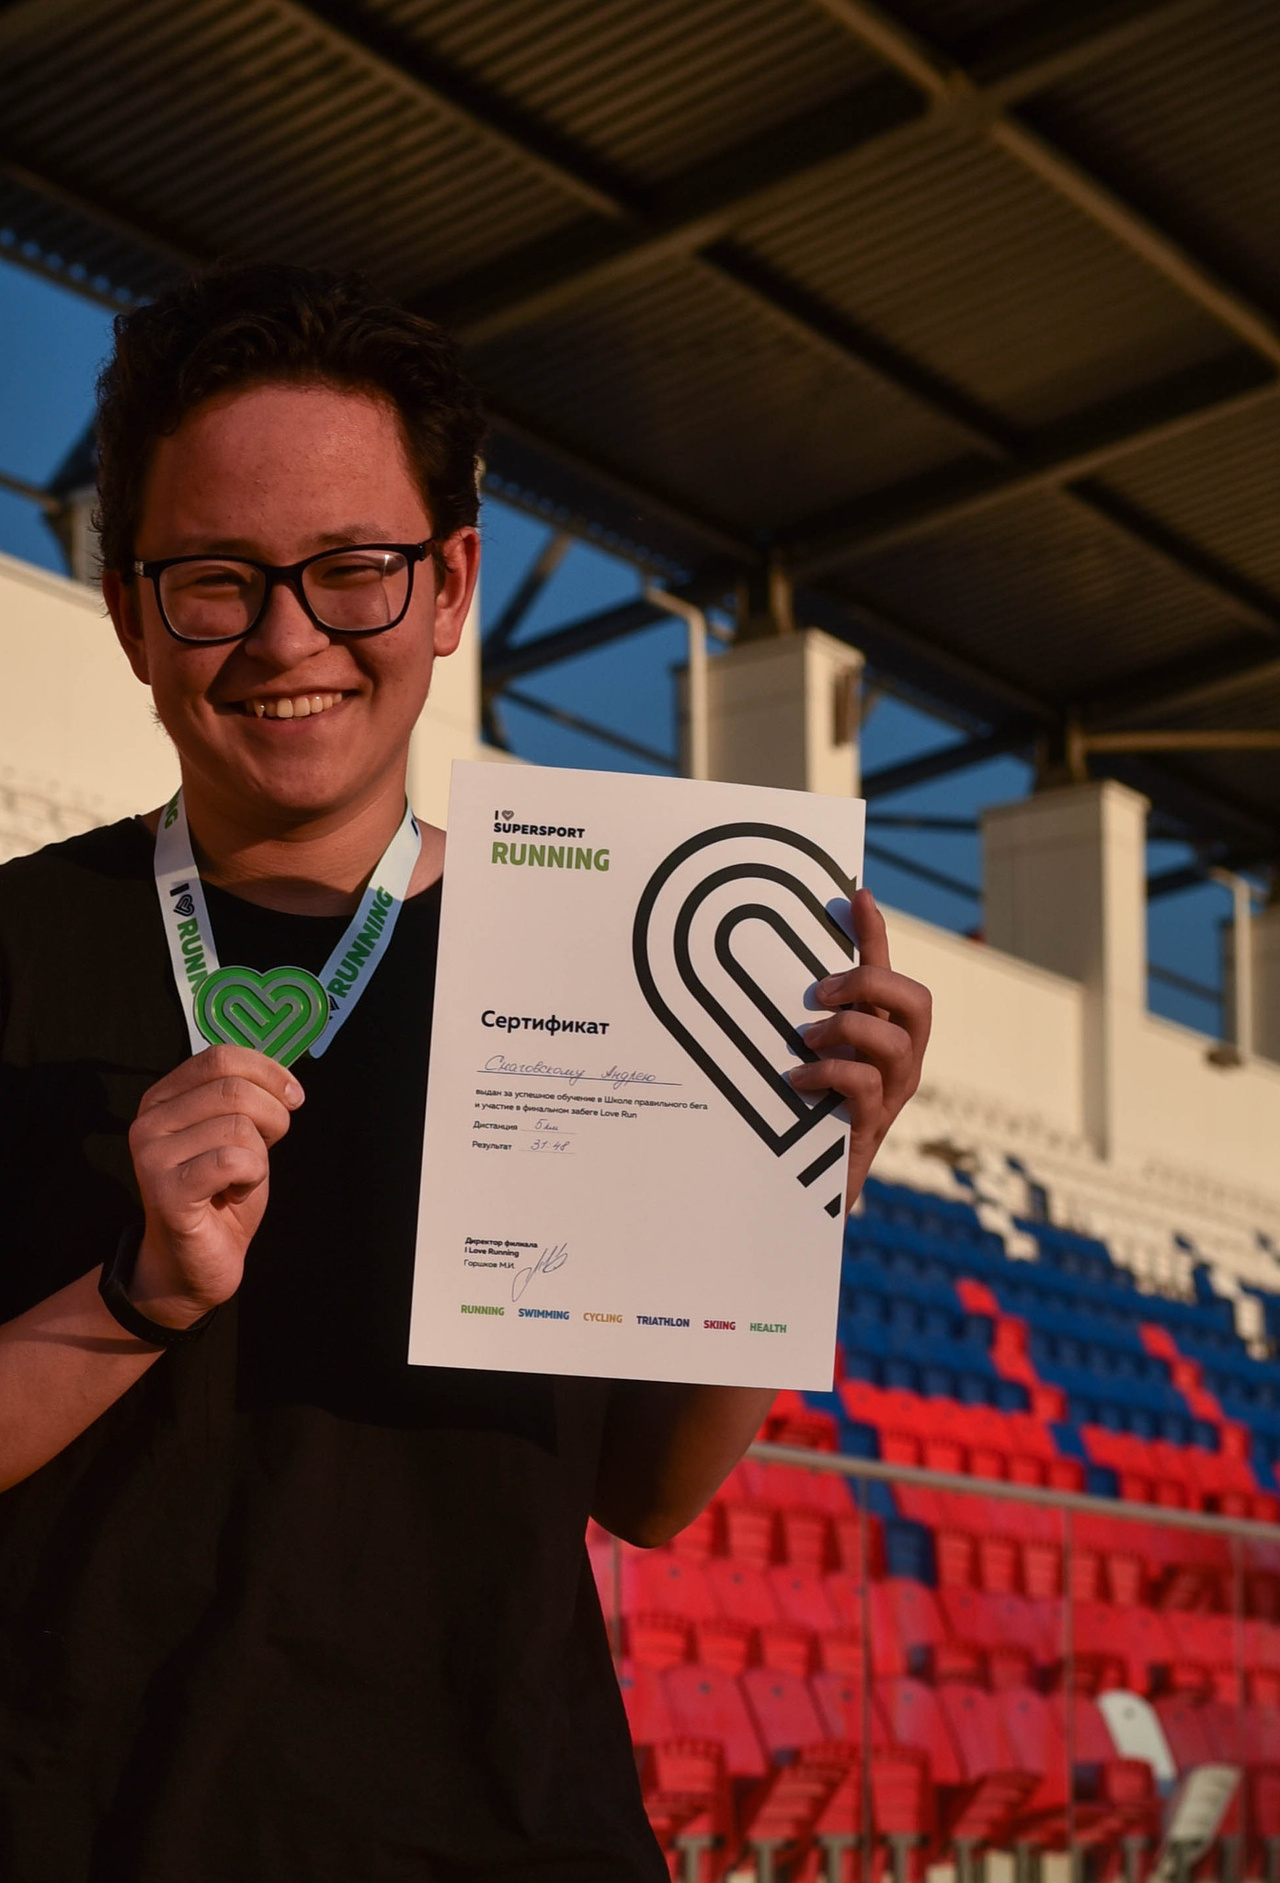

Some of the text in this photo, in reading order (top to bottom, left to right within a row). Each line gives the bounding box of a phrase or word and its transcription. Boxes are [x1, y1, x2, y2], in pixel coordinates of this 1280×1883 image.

[494, 810, 499, 820] I
[493, 822, 585, 838] SUPERSPORT
[491, 841, 610, 872] RUNNING
[326, 885, 394, 999] RUNNING
[481, 1010, 610, 1036] Сертификат
[475, 1089, 502, 1097] выдан
[514, 1091, 555, 1100] успешное
[556, 1093, 595, 1103] обучение
[604, 1095, 633, 1105] Школе
[634, 1099, 688, 1108] правильного
[689, 1101, 708, 1110] бега
[481, 1102, 514, 1111] участие
[522, 1105, 569, 1113] финальном
[571, 1108, 598, 1116] забеге
[600, 1109, 619, 1117] Love
[621, 1110, 637, 1118] Run
[473, 1120, 518, 1131] Дистанция
[472, 1140, 512, 1151] Результат
[465, 1237, 538, 1248] Директор филиала
[468, 1247, 487, 1255] Love
[488, 1248, 520, 1258] Running
[463, 1259, 498, 1268] Горшков
[460, 1304, 787, 1333] RUNNING SWIMMING CYCLING TRIATHLON SKIING HEALTH
